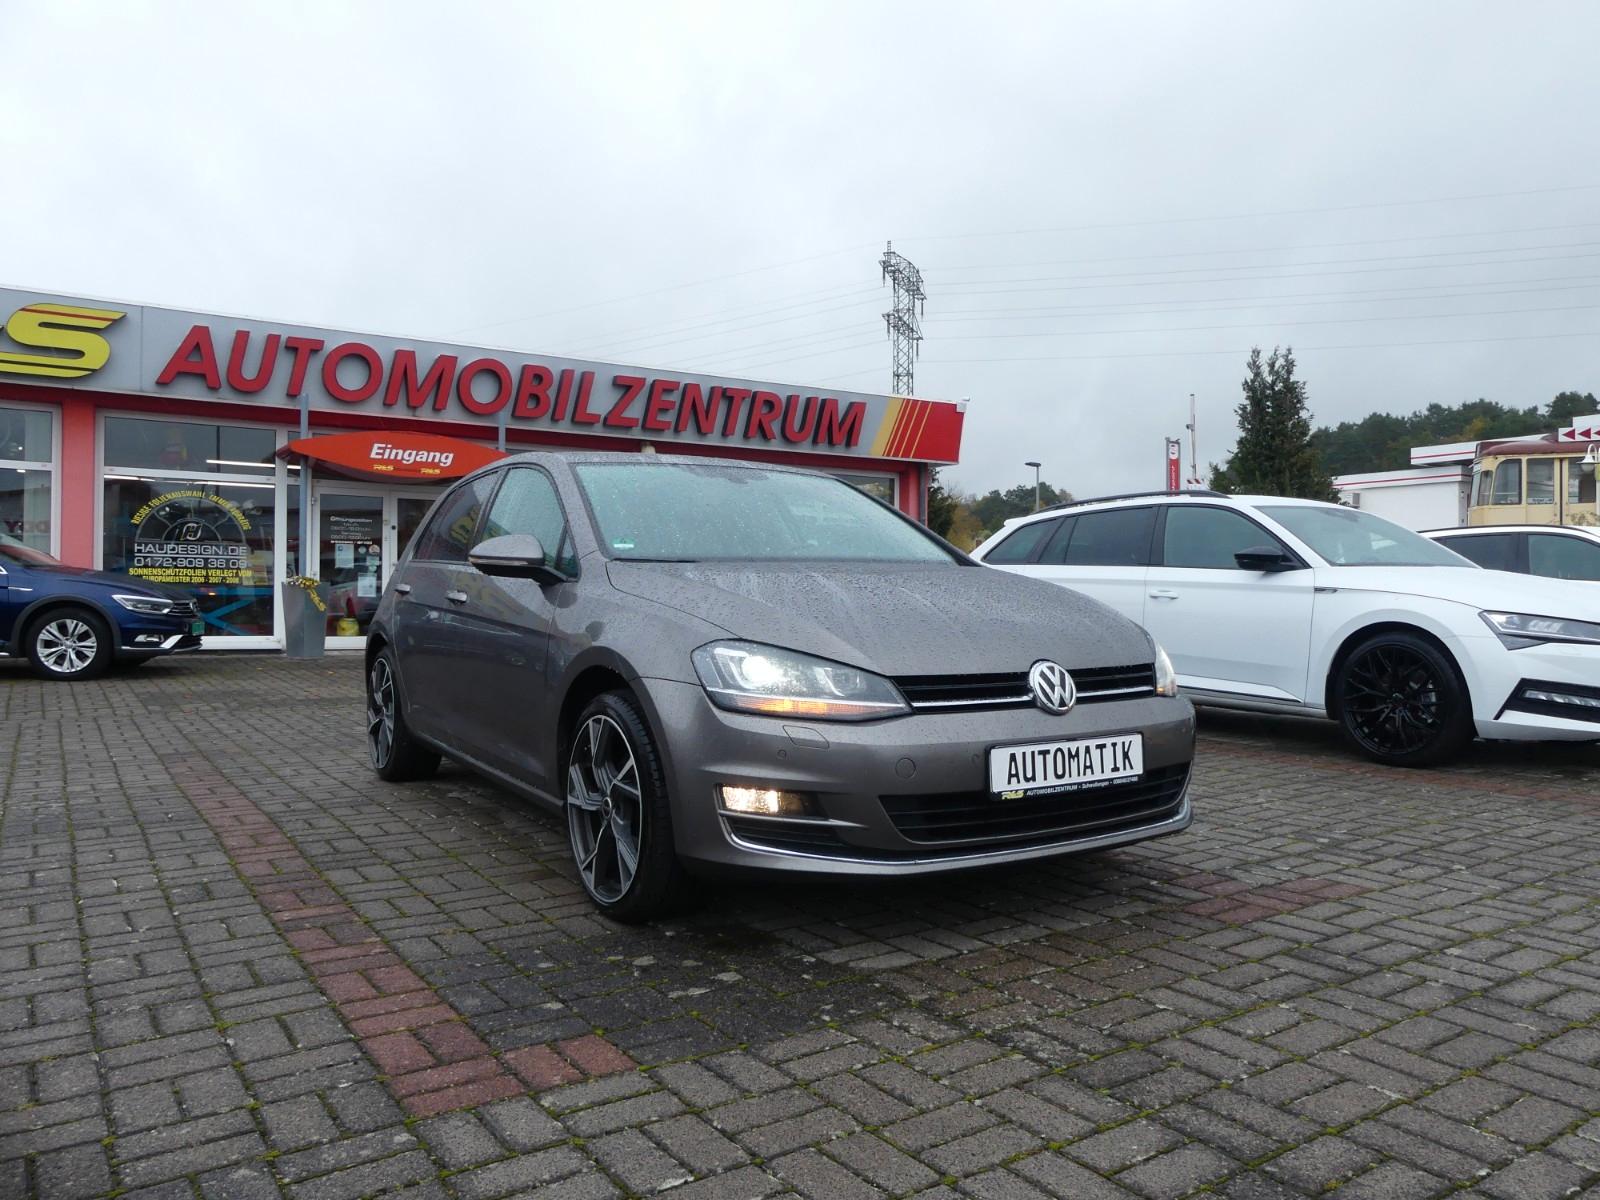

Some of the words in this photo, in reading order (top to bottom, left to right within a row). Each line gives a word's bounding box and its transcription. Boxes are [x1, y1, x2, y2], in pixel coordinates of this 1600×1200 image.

[155, 325, 867, 449] AUTOMOBILZENTRUM
[369, 443, 454, 467] Eingang
[134, 543, 248, 556] HAUDESIGN.DE
[134, 556, 205, 568] 0172-909
[207, 559, 226, 568] 36
[1007, 740, 1134, 785] AUTOMATIK
